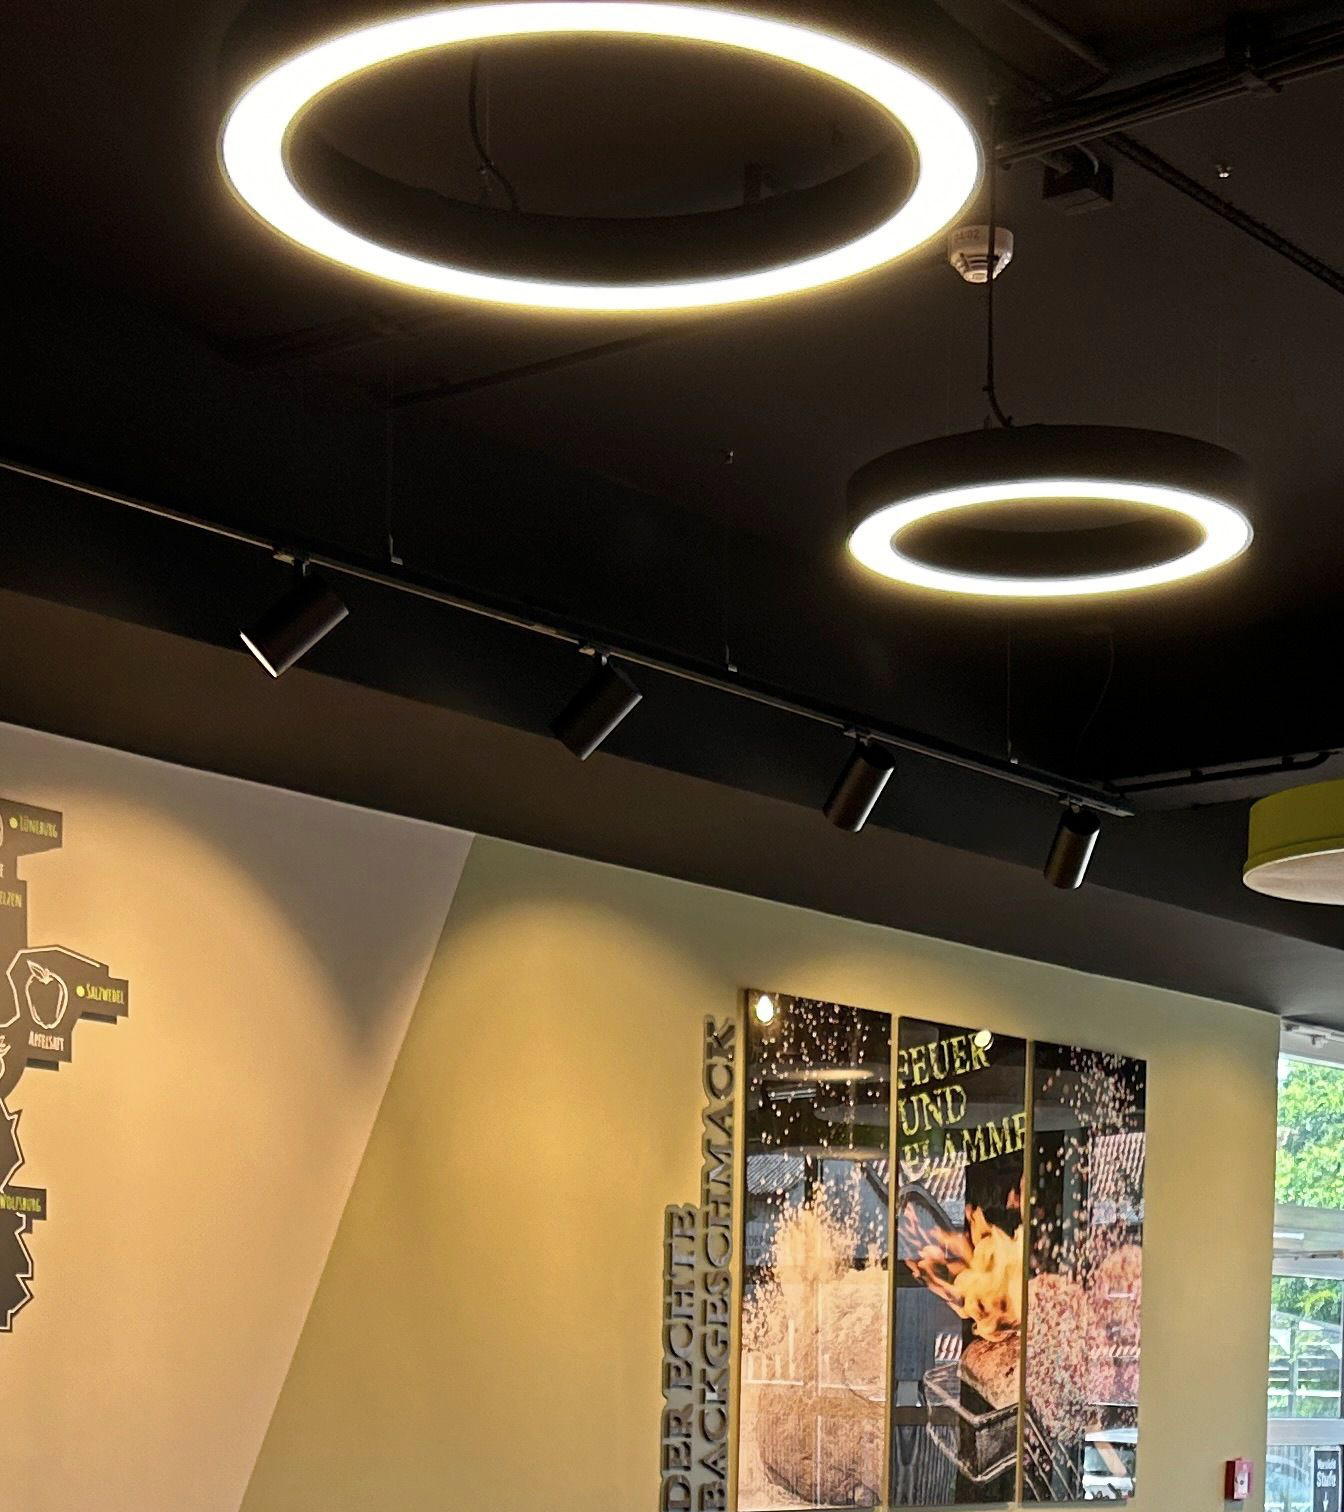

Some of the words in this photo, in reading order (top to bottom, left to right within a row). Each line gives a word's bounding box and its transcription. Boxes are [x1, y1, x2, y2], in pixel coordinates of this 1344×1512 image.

[898, 1085, 967, 1137] UND
[665, 1209, 696, 1391] ECHTE
[699, 1021, 736, 1512] BACKGESCHMACK
[664, 1403, 694, 1512] DER
